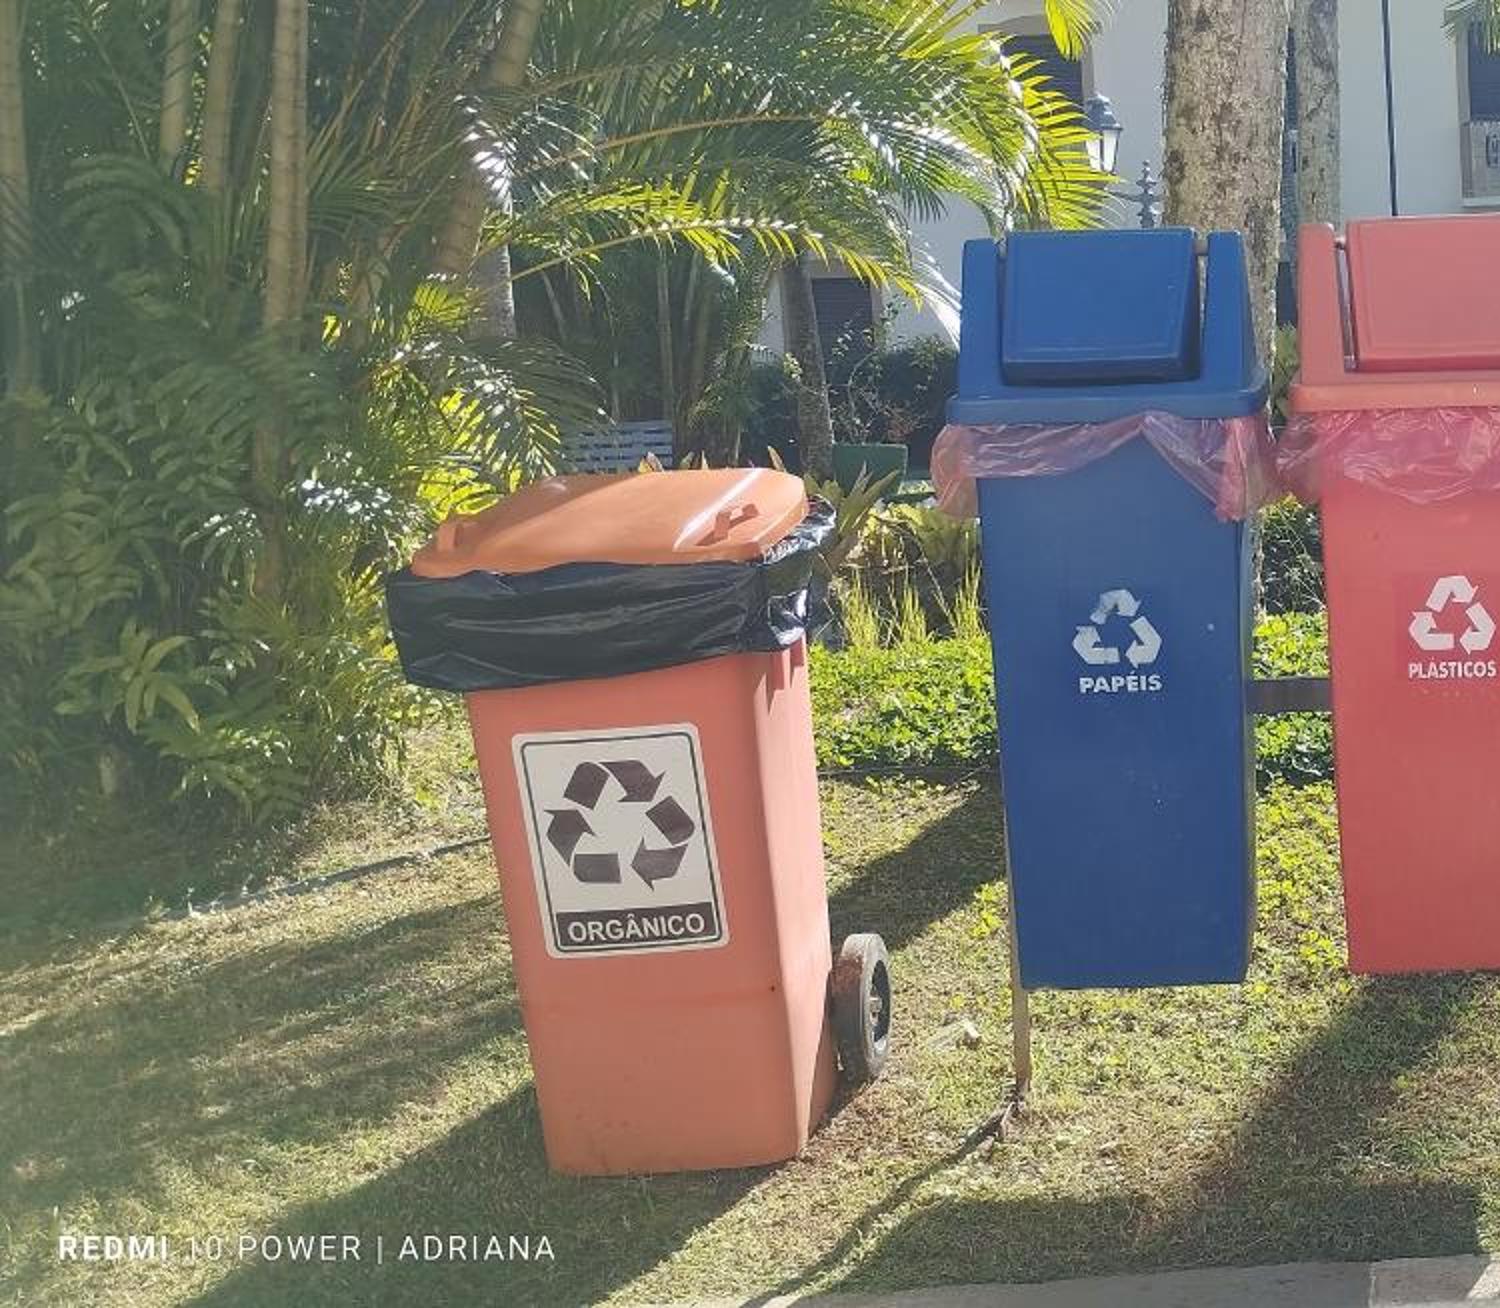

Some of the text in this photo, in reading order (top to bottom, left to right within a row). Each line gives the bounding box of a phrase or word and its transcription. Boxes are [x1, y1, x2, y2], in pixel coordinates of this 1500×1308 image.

[1408, 656, 1497, 679] PLÁSTICOS
[1079, 670, 1162, 693] PAPÉIS
[567, 912, 706, 942] ORGÂNICO
